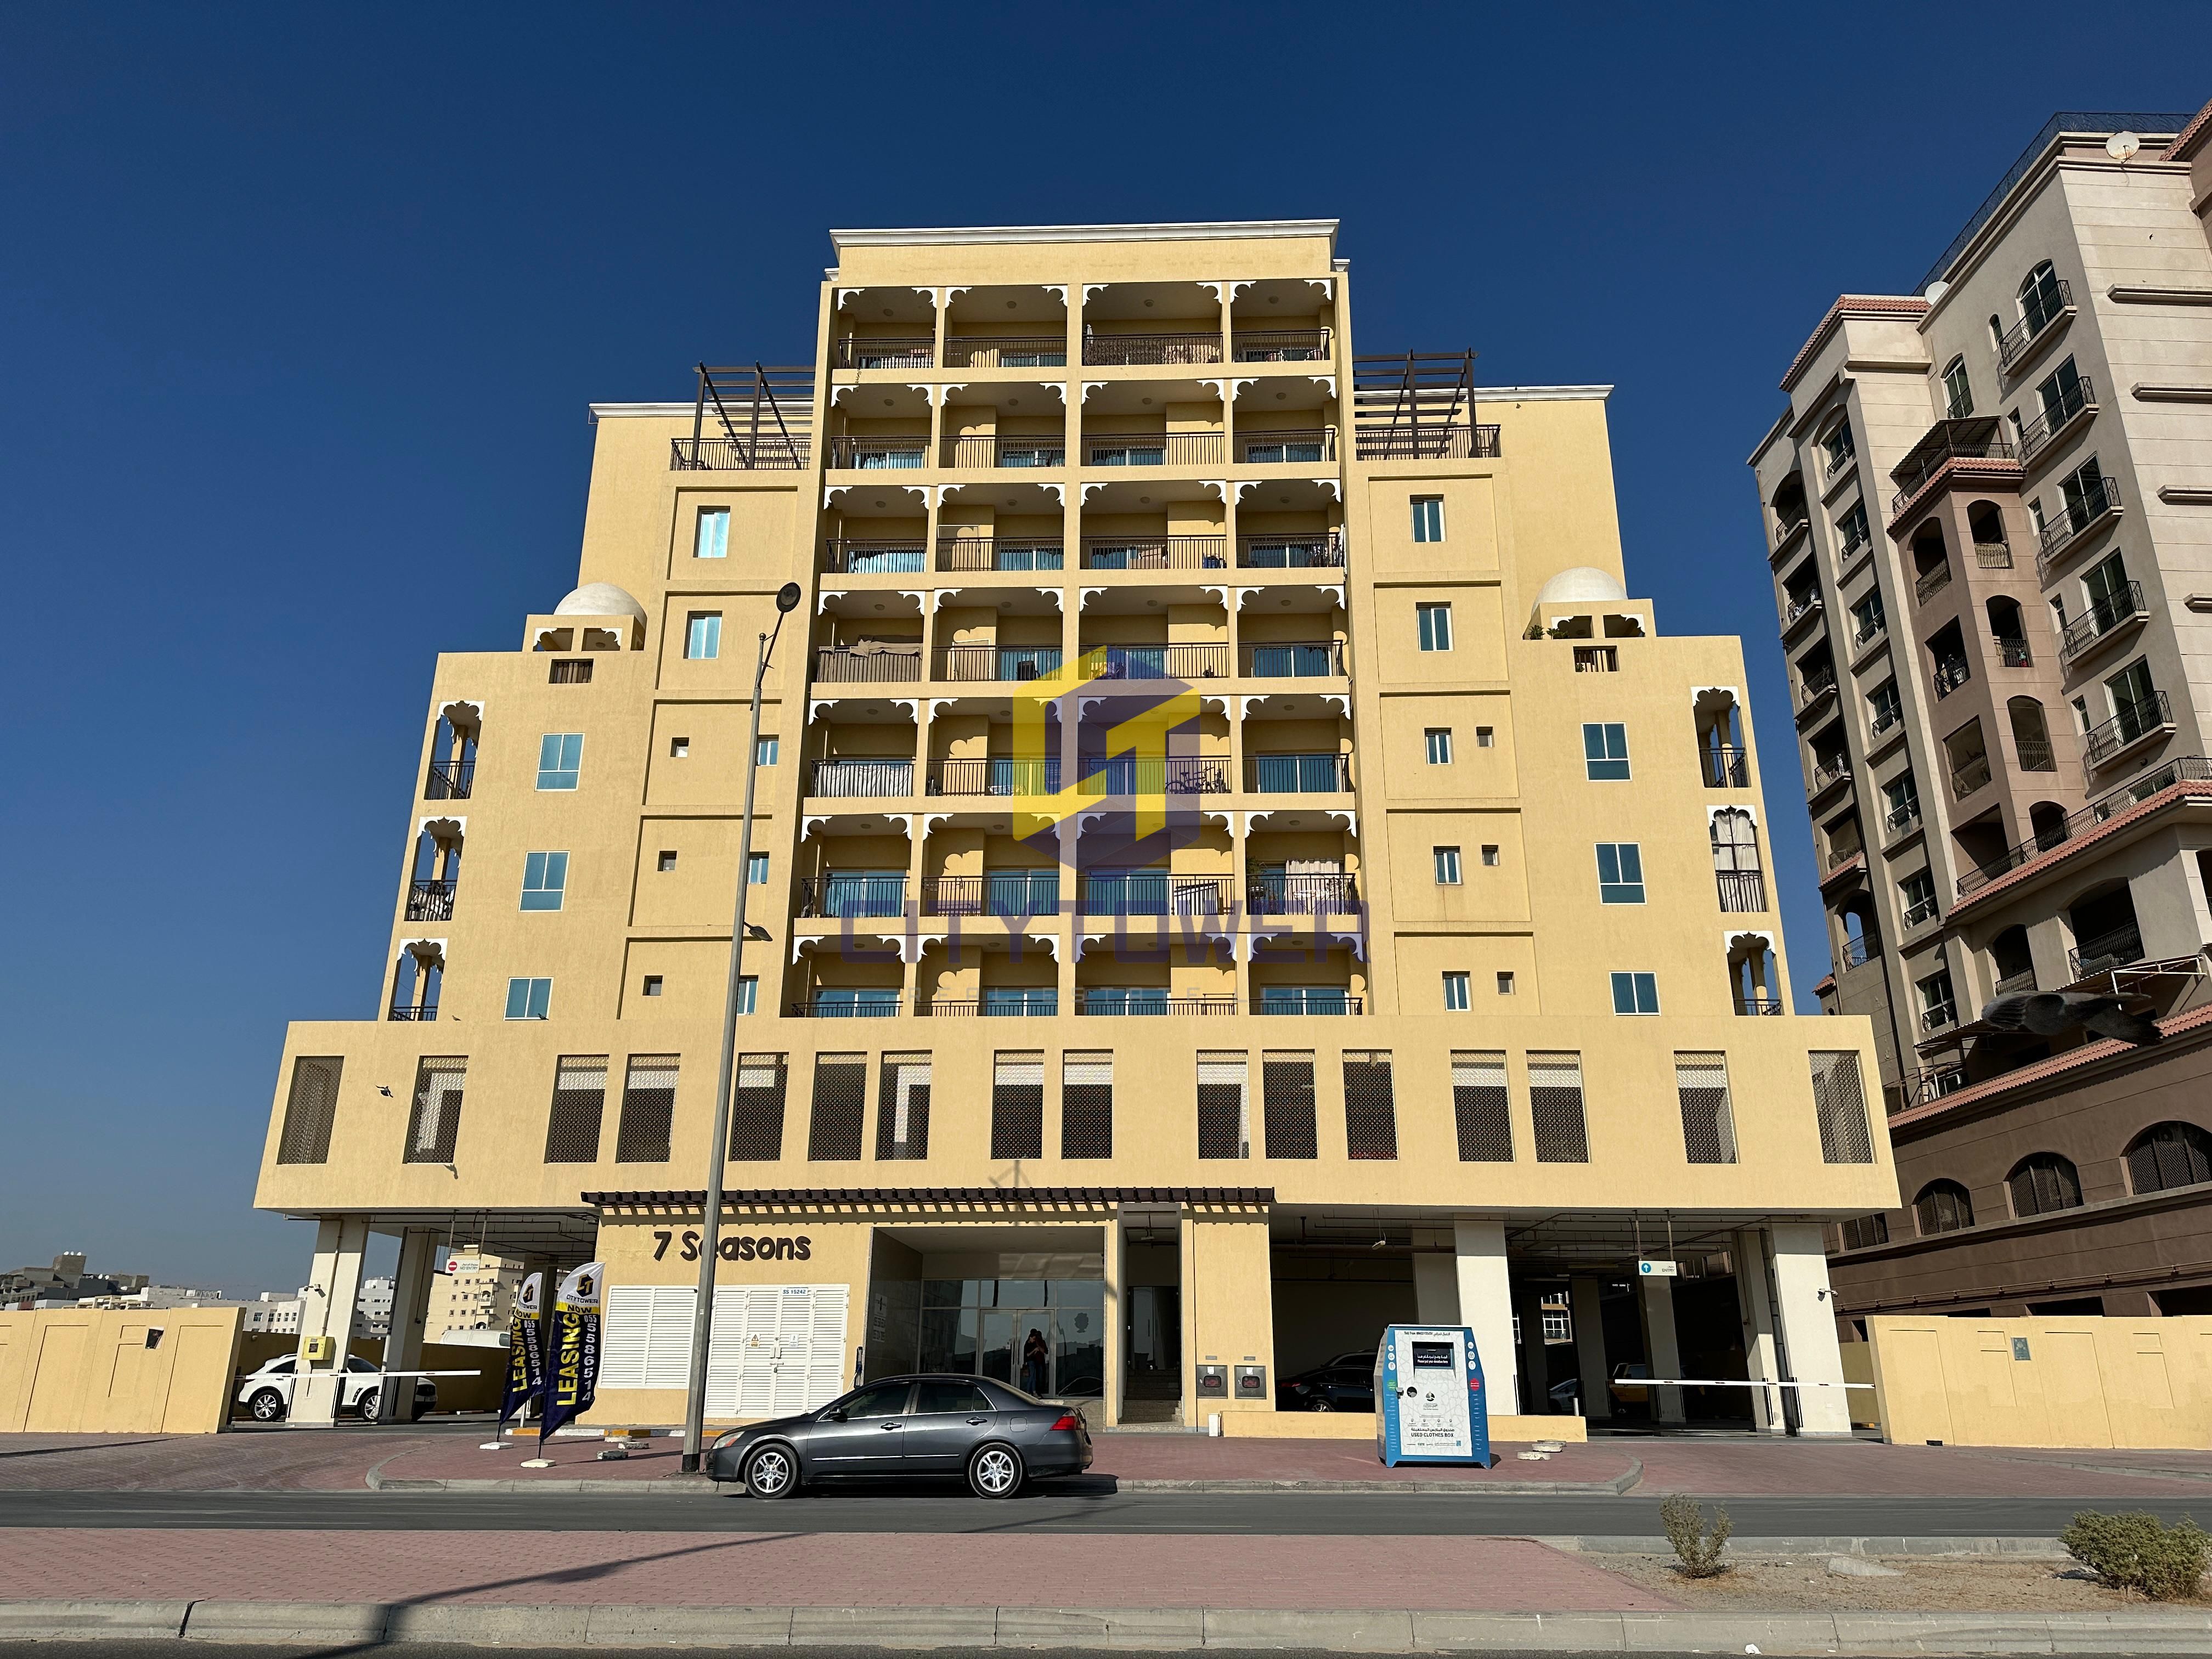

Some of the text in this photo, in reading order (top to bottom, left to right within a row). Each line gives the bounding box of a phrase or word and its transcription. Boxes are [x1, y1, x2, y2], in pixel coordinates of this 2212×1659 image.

[653, 1231, 811, 1261] 7 Sasons
[567, 1304, 592, 1313] NOW
[524, 1320, 535, 1328] 055
[512, 1316, 527, 1392] LEASING
[557, 1313, 580, 1406] LEASING
